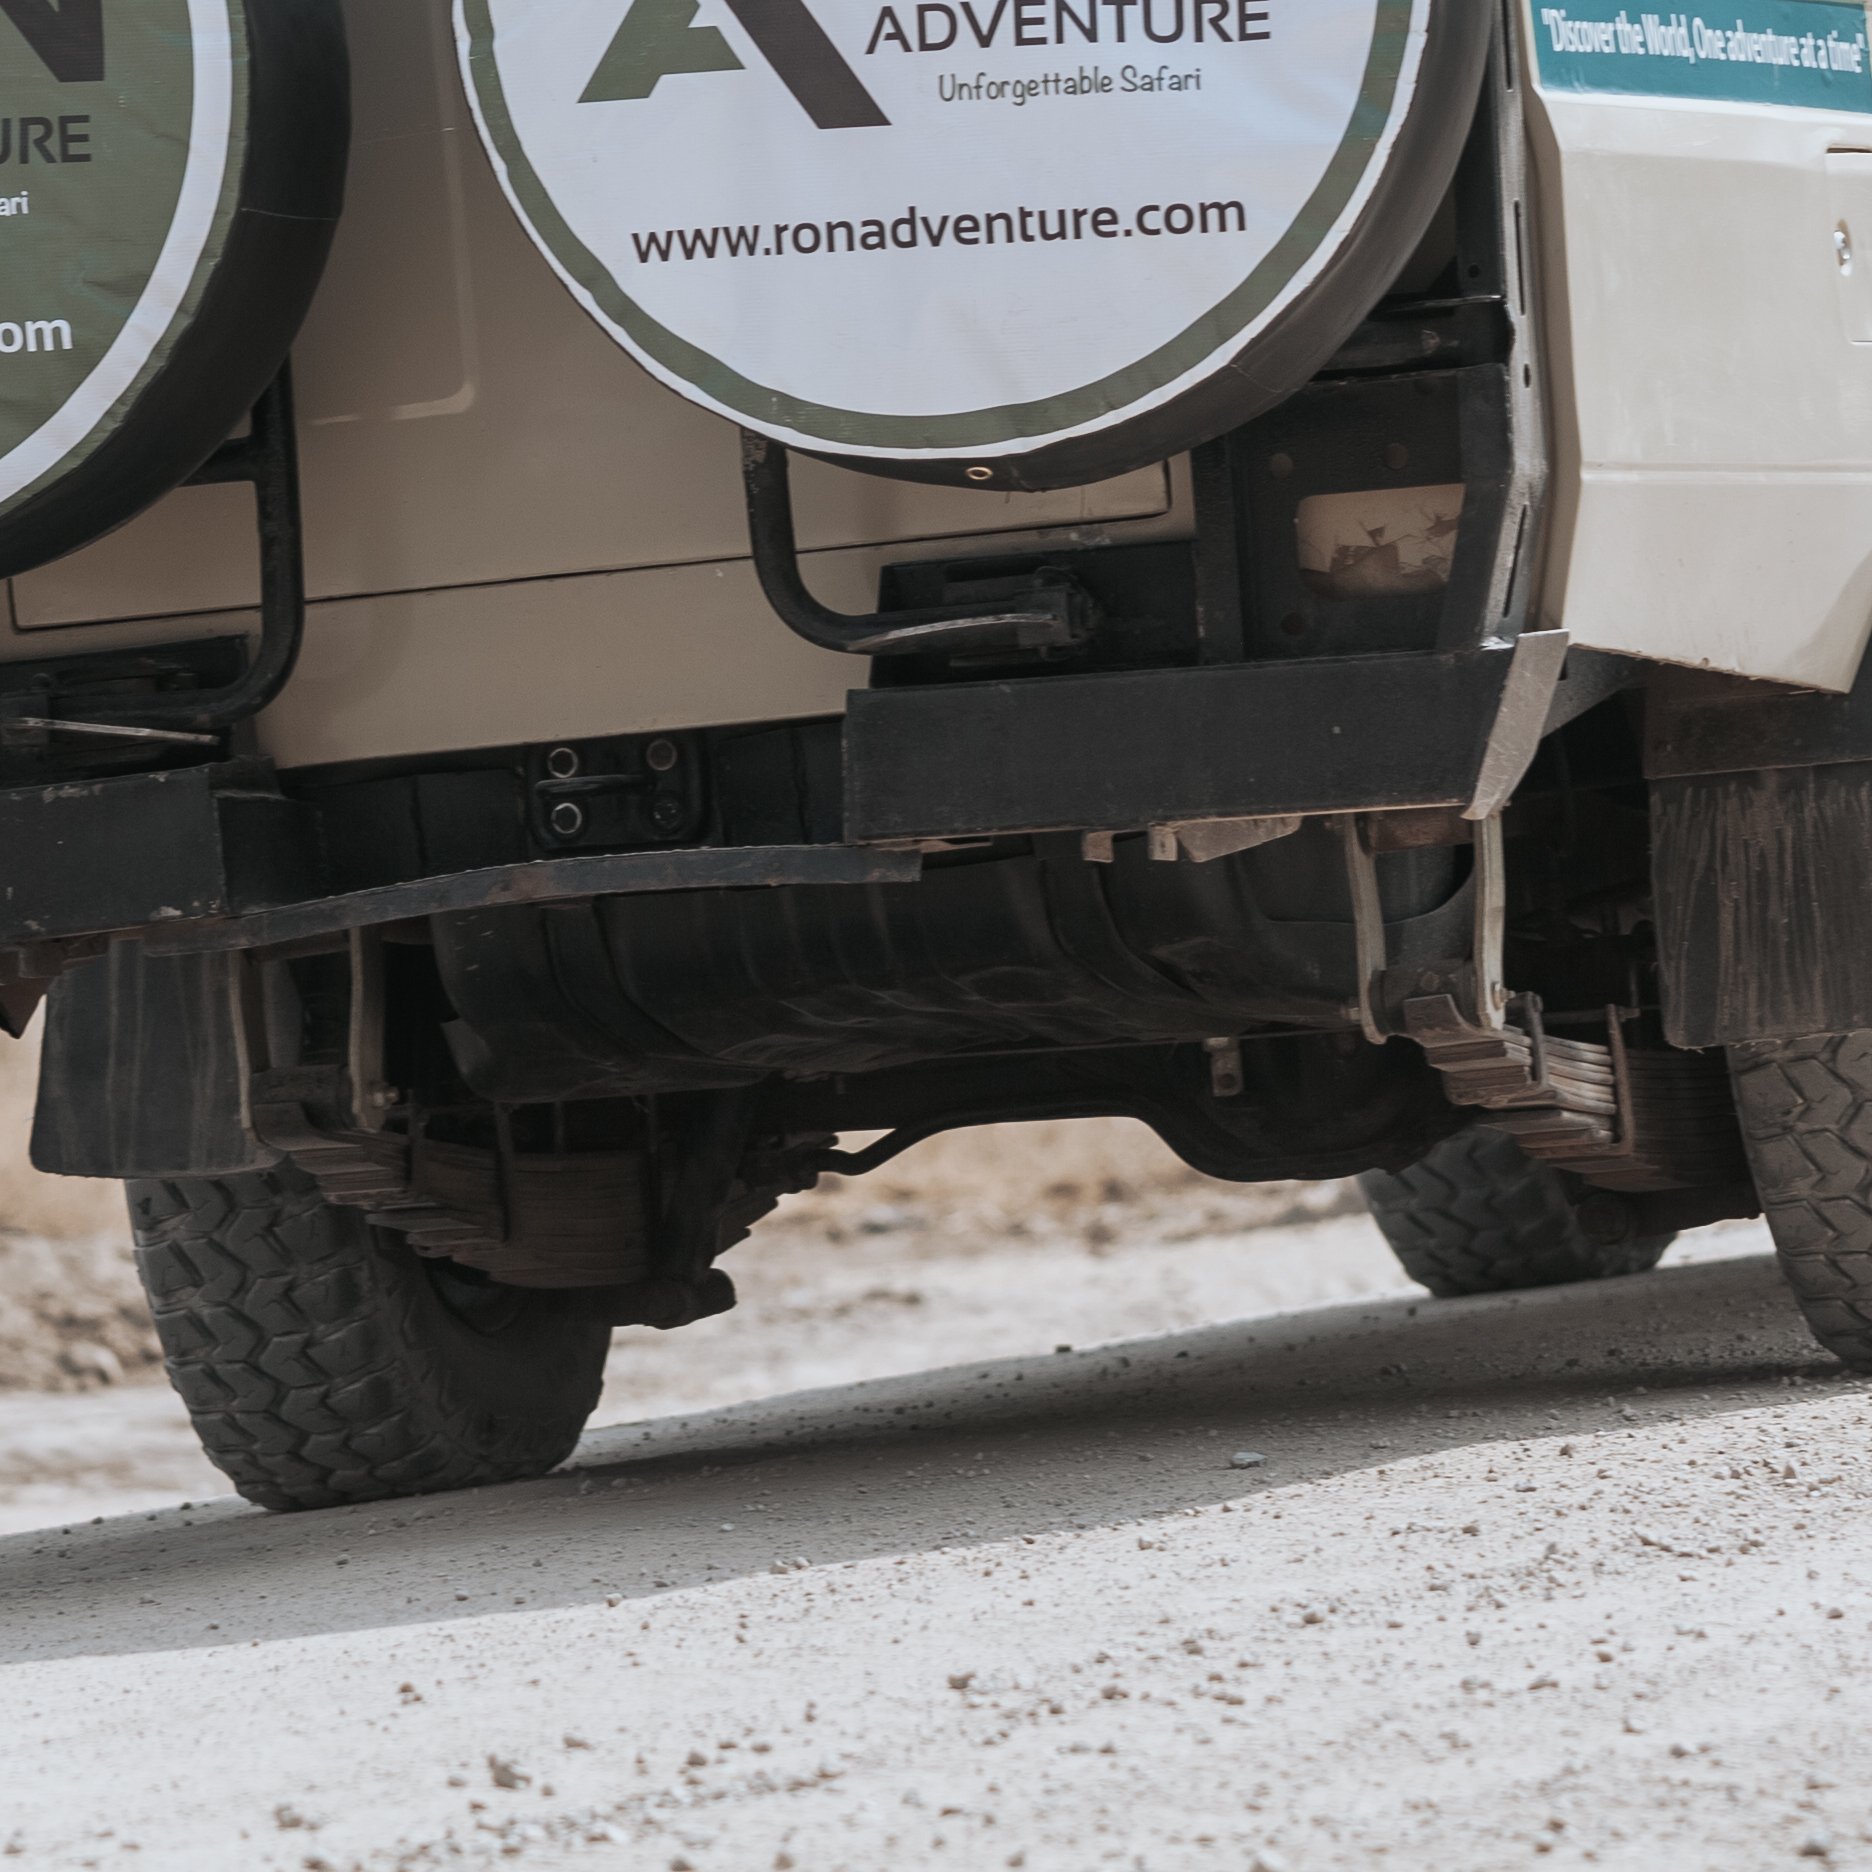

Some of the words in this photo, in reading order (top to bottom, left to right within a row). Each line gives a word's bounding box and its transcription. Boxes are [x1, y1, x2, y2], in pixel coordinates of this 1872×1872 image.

[1615, 10, 1645, 55] the
[1641, 14, 1695, 64] World,
[1692, 17, 1727, 60] One
[1725, 19, 1800, 66] adventure
[1799, 32, 1817, 68] at
[1816, 38, 1828, 70] a
[938, 65, 1113, 106] Unforgettable
[1121, 65, 1202, 93] Safari
[631, 198, 1247, 264] www.ronadventure.com
